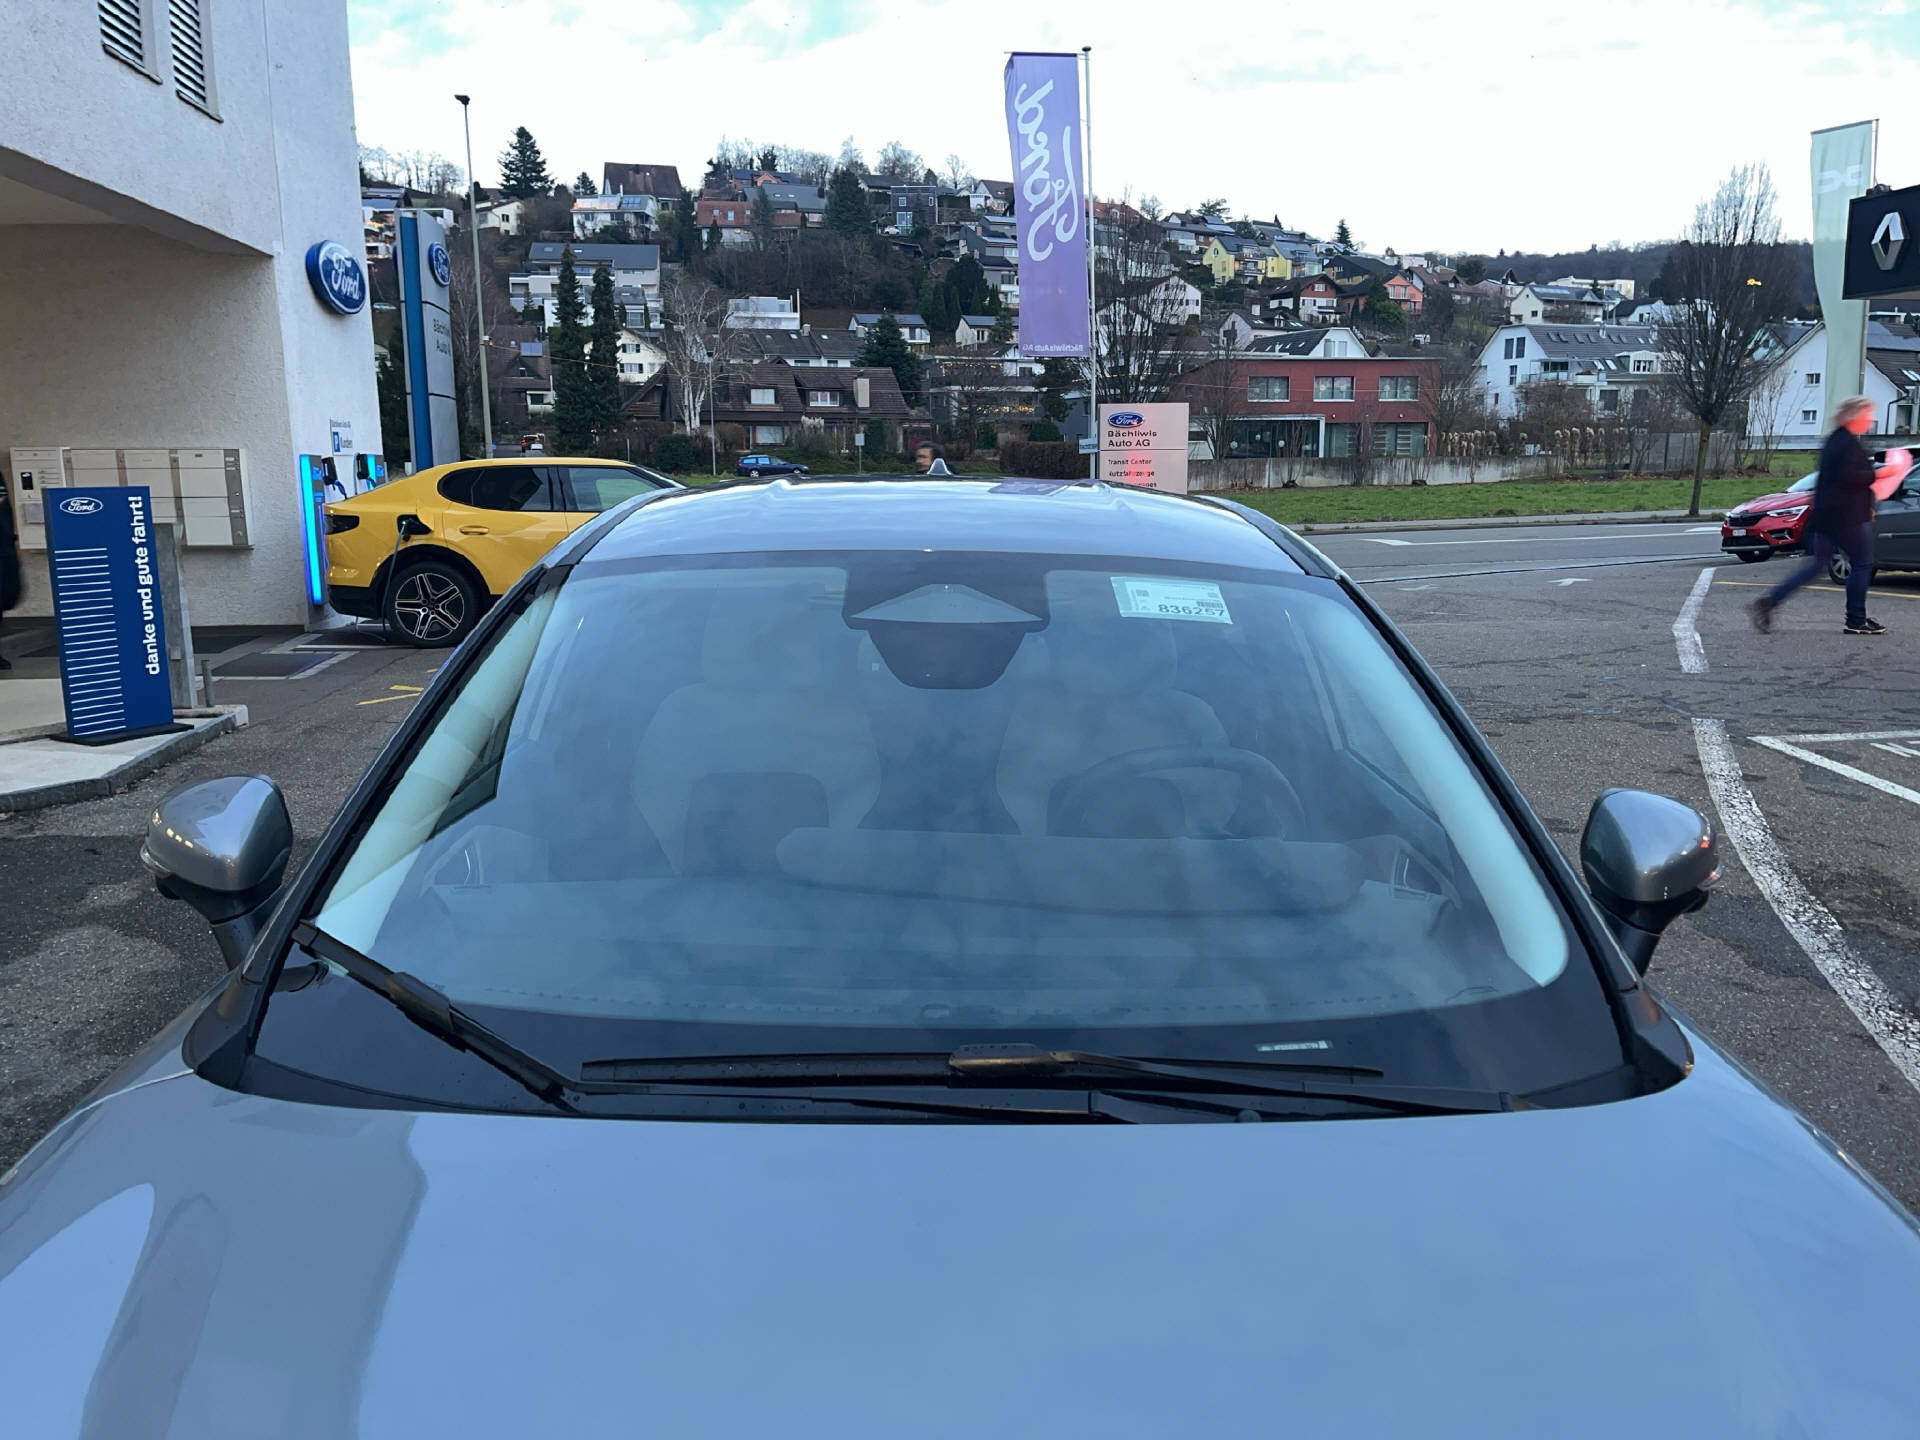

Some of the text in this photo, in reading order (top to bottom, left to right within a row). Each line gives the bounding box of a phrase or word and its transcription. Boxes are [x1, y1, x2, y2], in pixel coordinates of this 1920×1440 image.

[1107, 430, 1157, 438] Bächliwis
[1135, 439, 1150, 447] AG
[128, 495, 159, 675] danke und gute fahrt!
[1157, 604, 1225, 617] 836257
